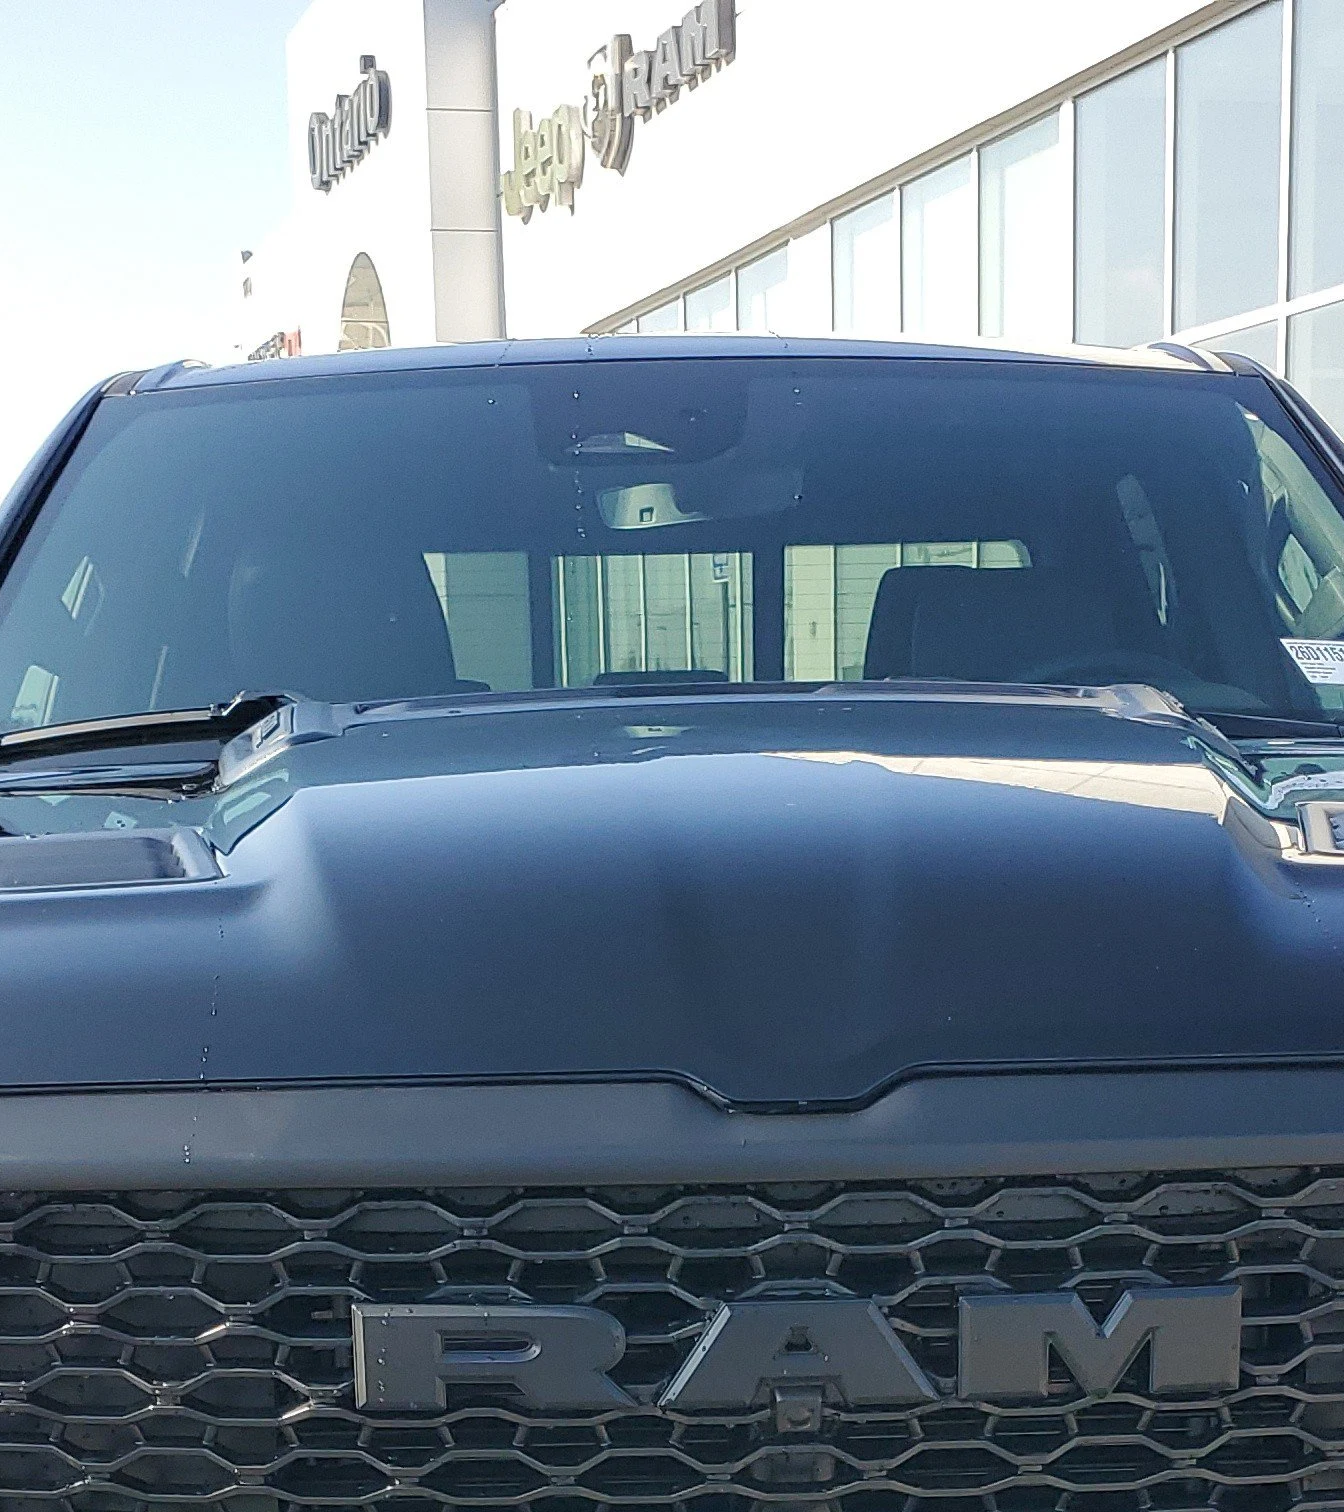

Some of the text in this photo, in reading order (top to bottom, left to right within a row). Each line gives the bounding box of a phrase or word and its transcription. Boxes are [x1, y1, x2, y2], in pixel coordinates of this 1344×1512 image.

[622, 0, 736, 124] RAM
[501, 106, 585, 225] Jeep
[351, 1284, 1242, 1410] RAM
